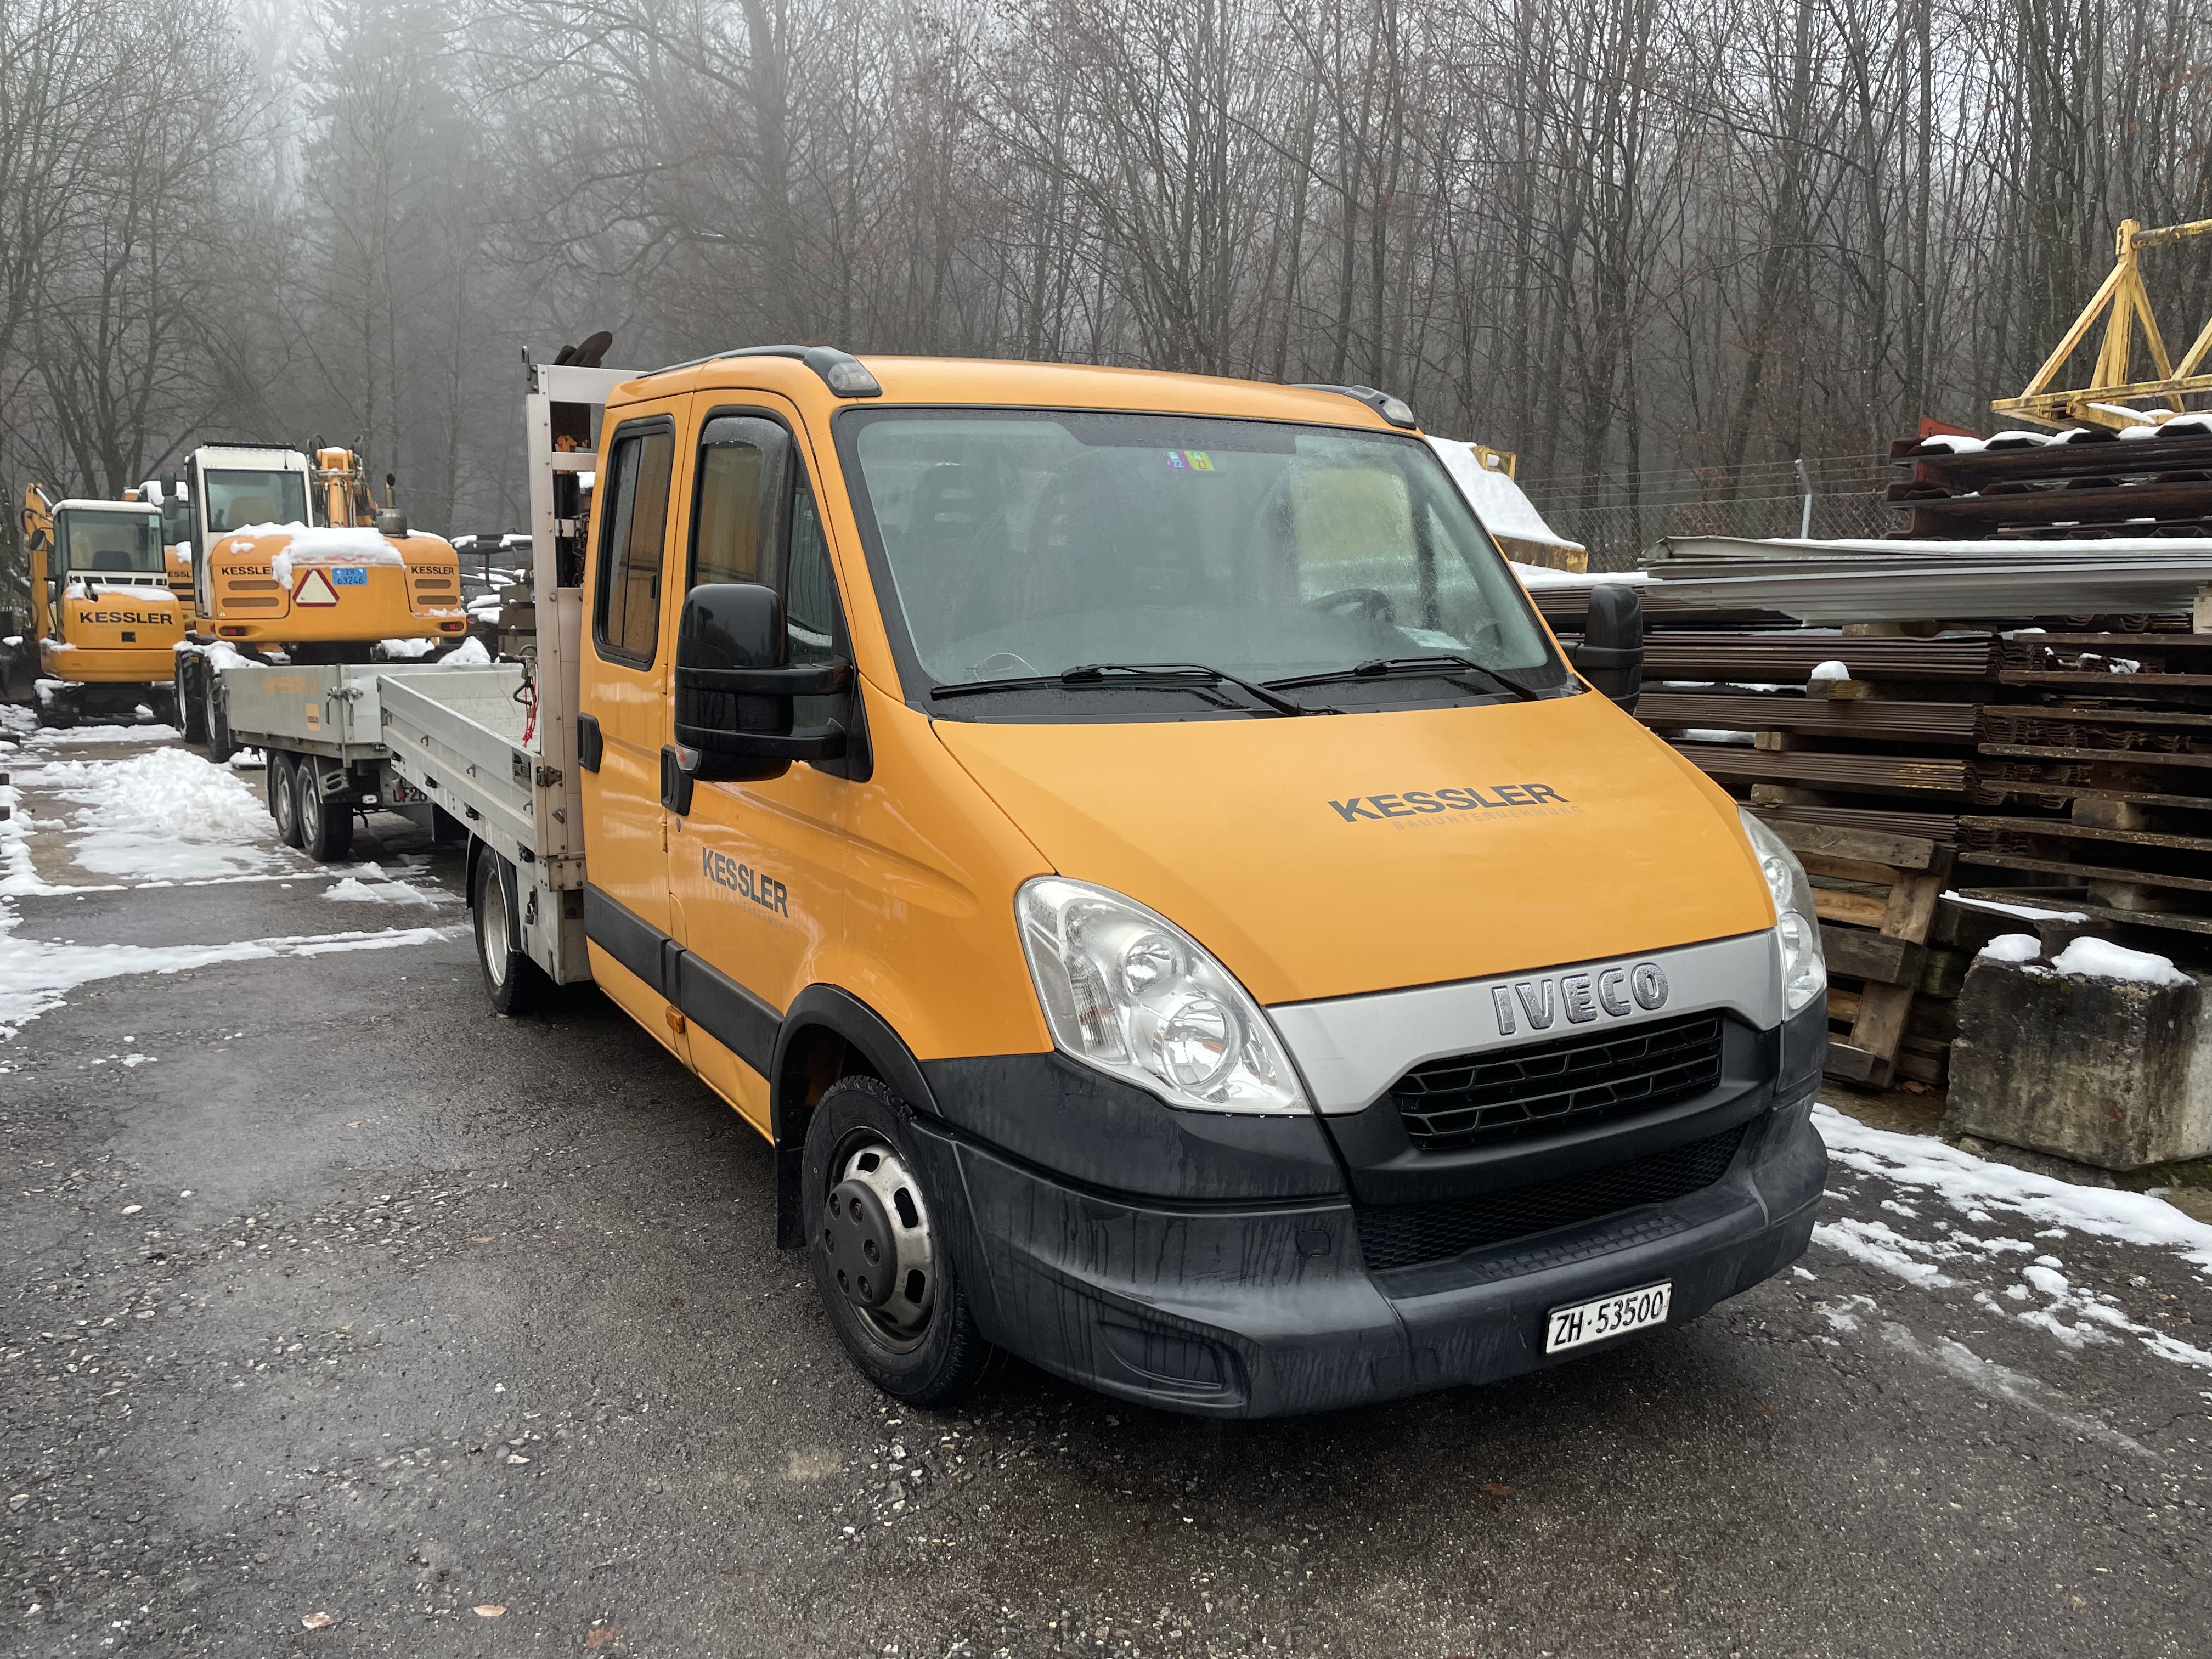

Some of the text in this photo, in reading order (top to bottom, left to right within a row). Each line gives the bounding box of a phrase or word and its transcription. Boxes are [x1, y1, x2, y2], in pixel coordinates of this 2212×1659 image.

[1171, 459, 1184, 469] 22
[1196, 460, 1209, 469] 21
[221, 566, 274, 575] KESSLE
[411, 566, 454, 575] KESSLER
[80, 612, 173, 625] KESSLER
[1327, 783, 1571, 823] KESSLER
[1392, 805, 1584, 830] BAUUNTERNEHMUNG
[702, 847, 788, 918] KESSLER
[1492, 962, 1668, 1036] IVECO
